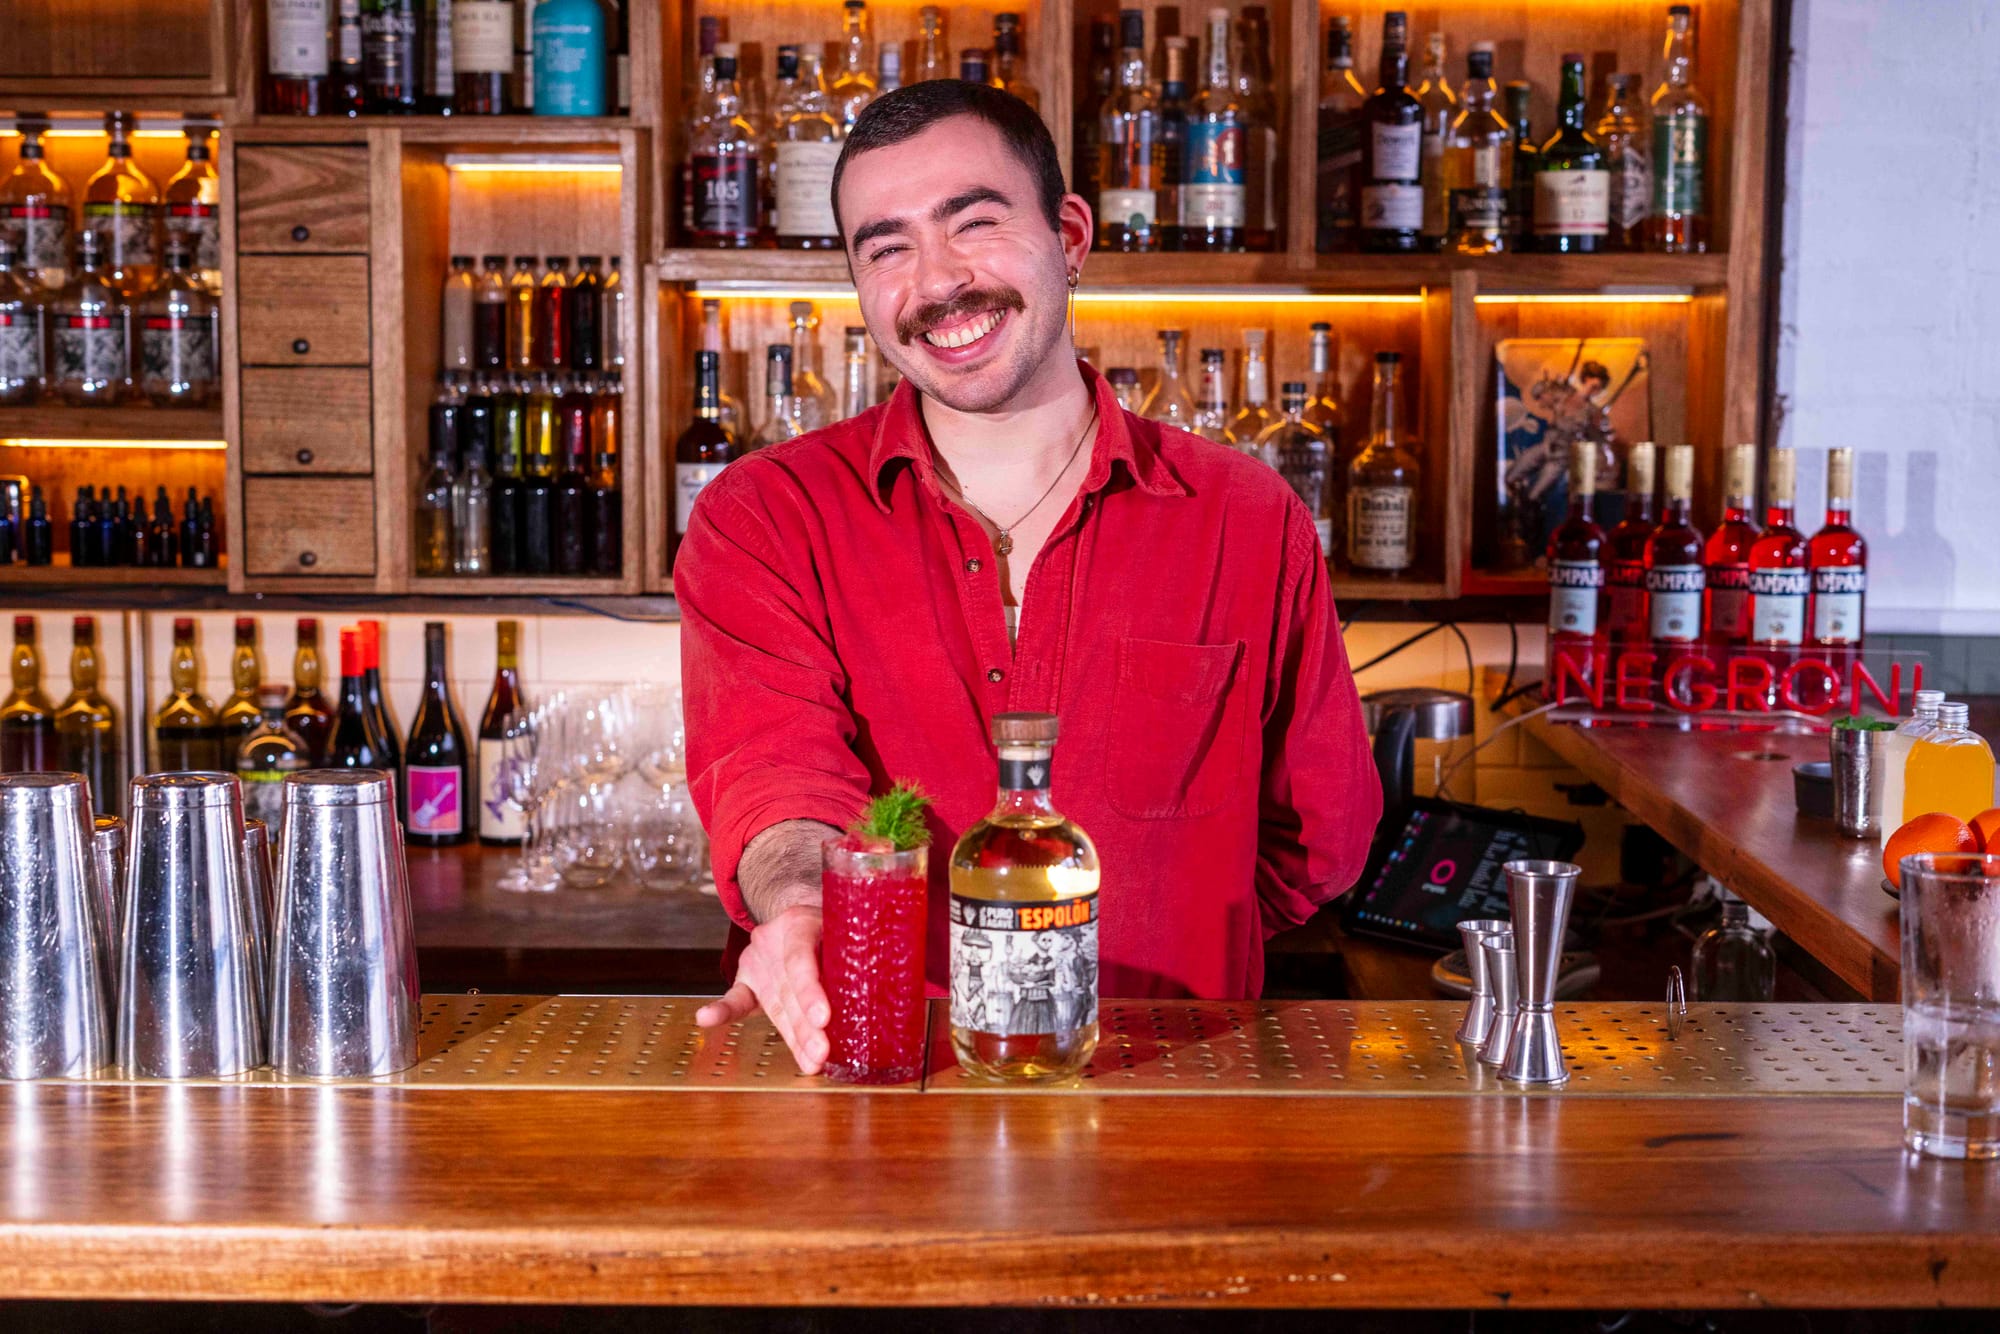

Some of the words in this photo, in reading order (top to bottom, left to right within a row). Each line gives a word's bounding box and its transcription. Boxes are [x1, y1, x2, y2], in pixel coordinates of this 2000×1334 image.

[706, 180, 739, 200] 105
[1646, 571, 1706, 591] CAMPARI
[1750, 573, 1810, 593] CAMPARI
[1554, 651, 1923, 717] NEGRONI
